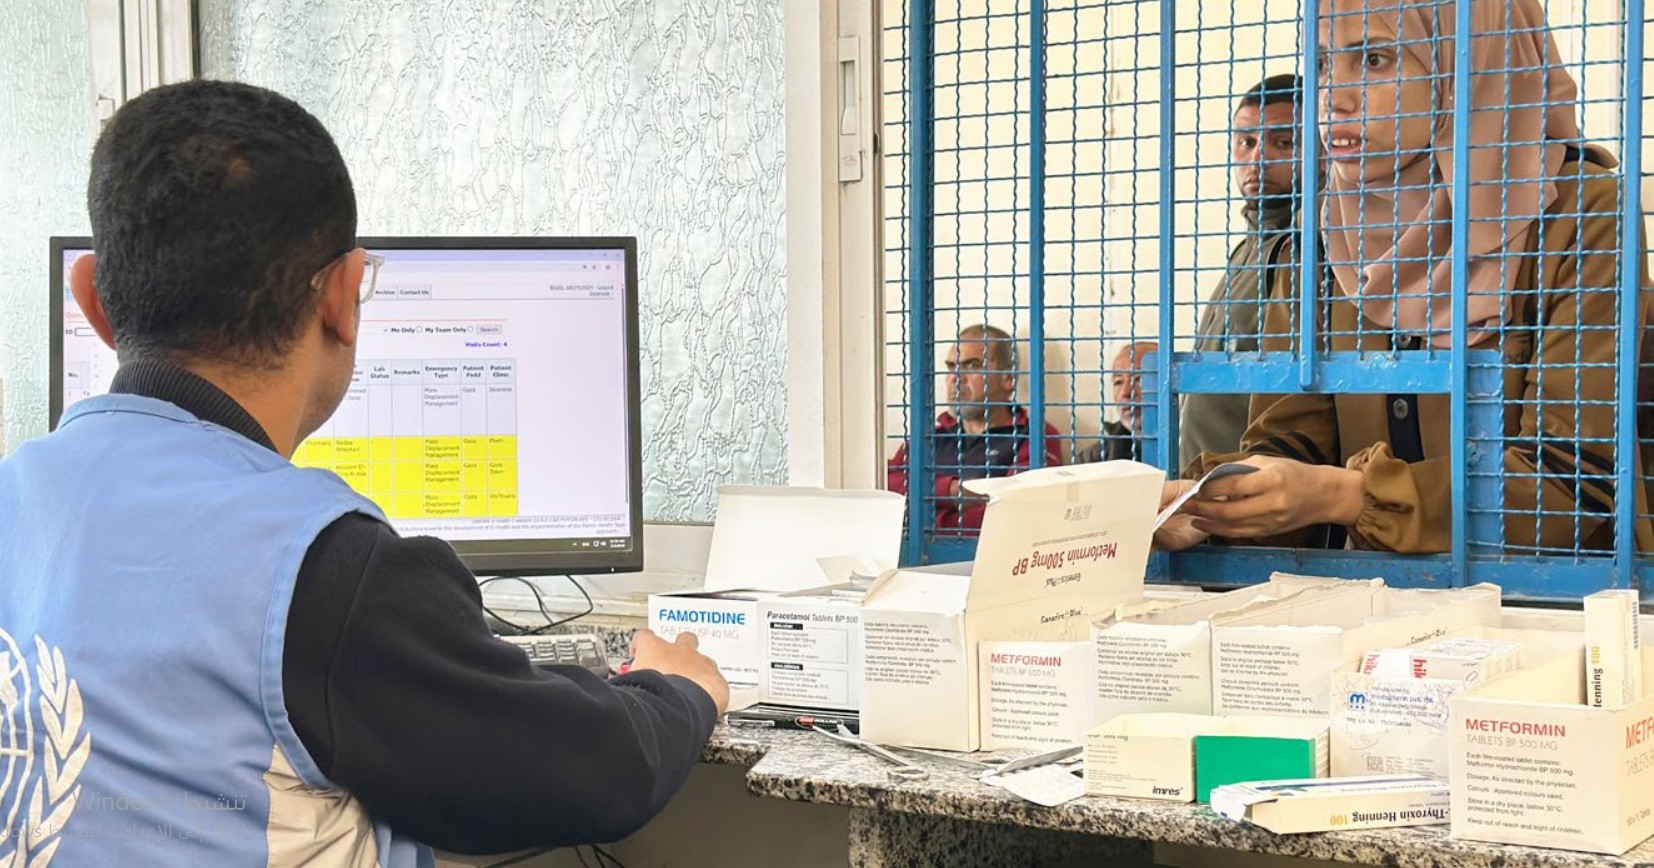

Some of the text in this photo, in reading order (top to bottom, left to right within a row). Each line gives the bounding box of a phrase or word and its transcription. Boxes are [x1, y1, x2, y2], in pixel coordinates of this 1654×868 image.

[1012, 542, 1118, 576] Metformin 500mg BP
[659, 609, 746, 625] FAMOTIDINE
[767, 611, 810, 621] Paracetamol
[991, 653, 1061, 666] METFORMIN
[992, 666, 1017, 675] TABLETS
[1414, 659, 1427, 678] hik
[1465, 718, 1565, 737] METFORMIN
[1466, 734, 1558, 750] TABLETS BP 500 MG
[1466, 760, 1495, 768] Metformin
[1494, 788, 1522, 796] Approved
[1330, 807, 1450, 825] -Thyroxin Henning 100
[1467, 805, 1494, 813] protected
